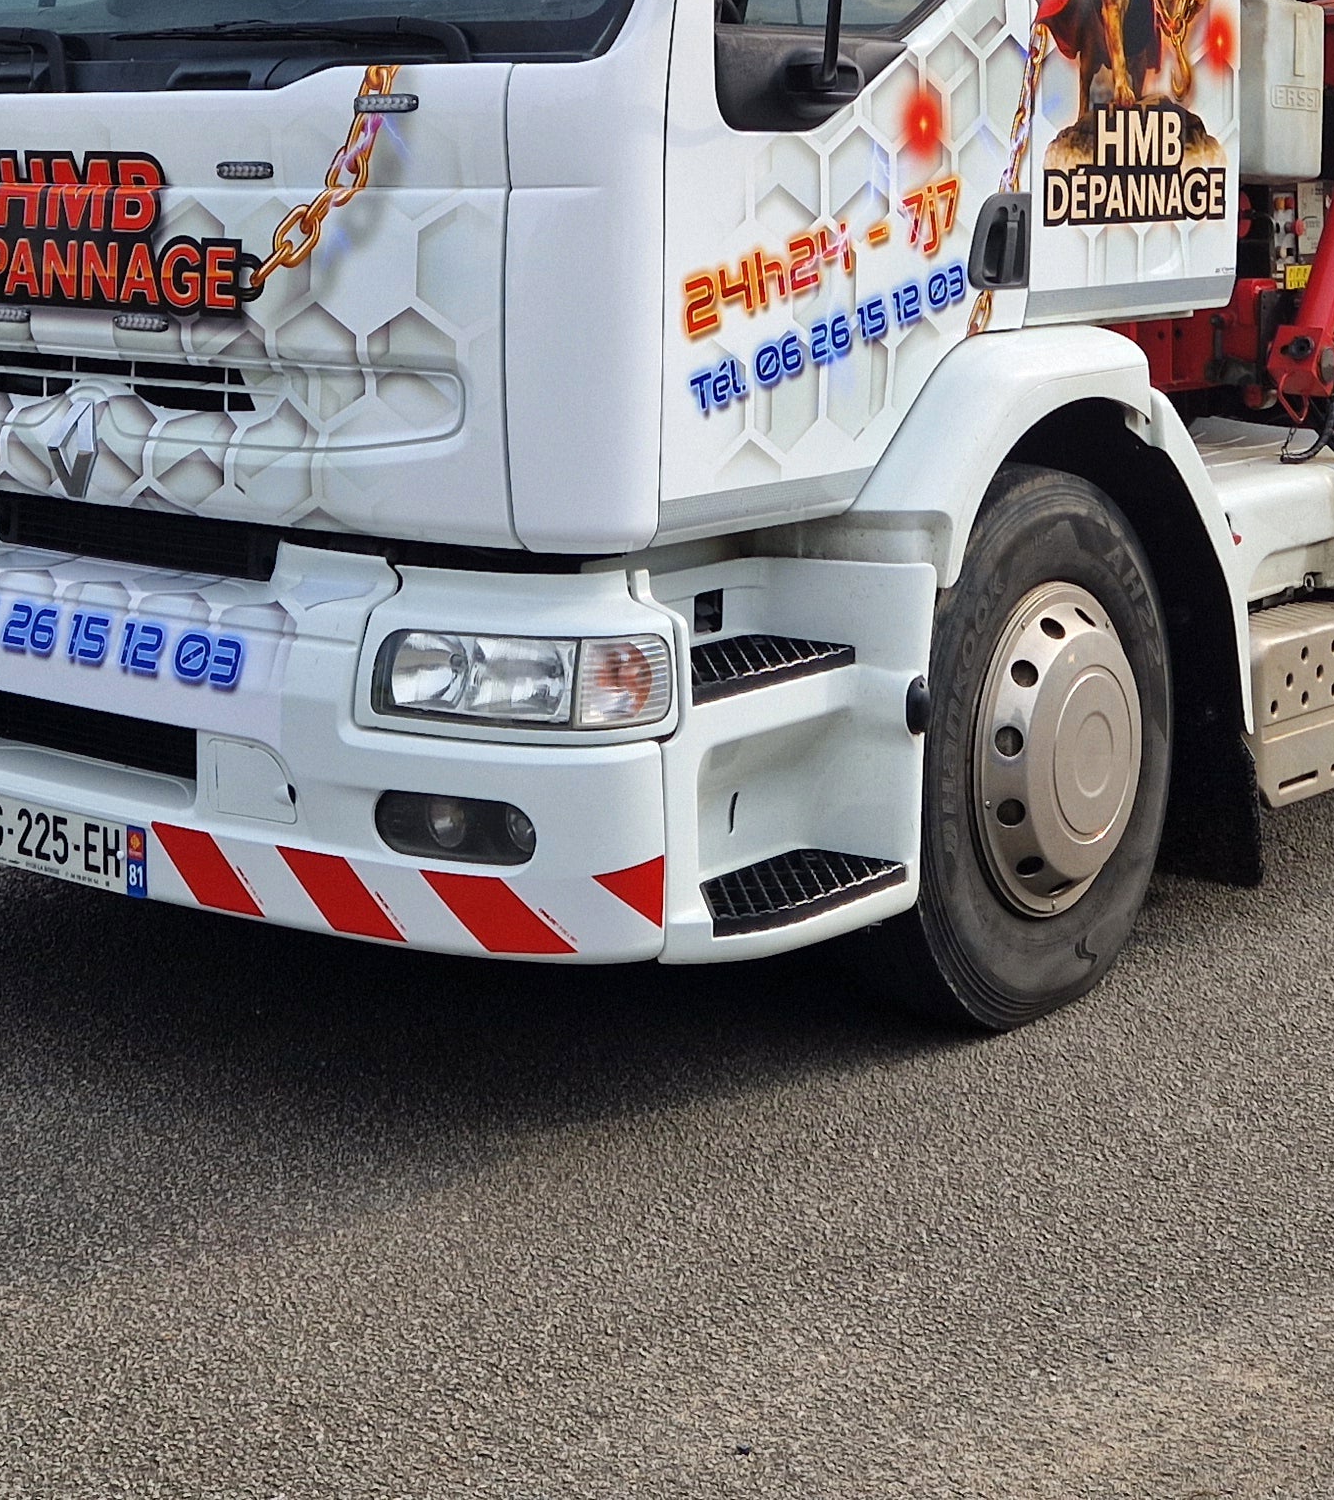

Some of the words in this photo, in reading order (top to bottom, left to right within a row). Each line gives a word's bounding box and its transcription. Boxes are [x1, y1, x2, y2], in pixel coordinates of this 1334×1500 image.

[1097, 109, 1182, 167] HMB
[1047, 168, 1224, 220] DÉPANNAGE
[685, 223, 852, 334] 24h24
[901, 179, 958, 254] 7j7
[690, 359, 747, 409] Tél.
[756, 335, 802, 382] 06
[811, 315, 850, 360] 26
[857, 300, 886, 338] 15
[892, 285, 920, 322] 12
[928, 265, 964, 306] 03
[3, 604, 58, 650] 26
[68, 614, 110, 659] 15
[120, 622, 163, 669] 12
[175, 633, 242, 684] 03
[129, 863, 143, 888] 81
